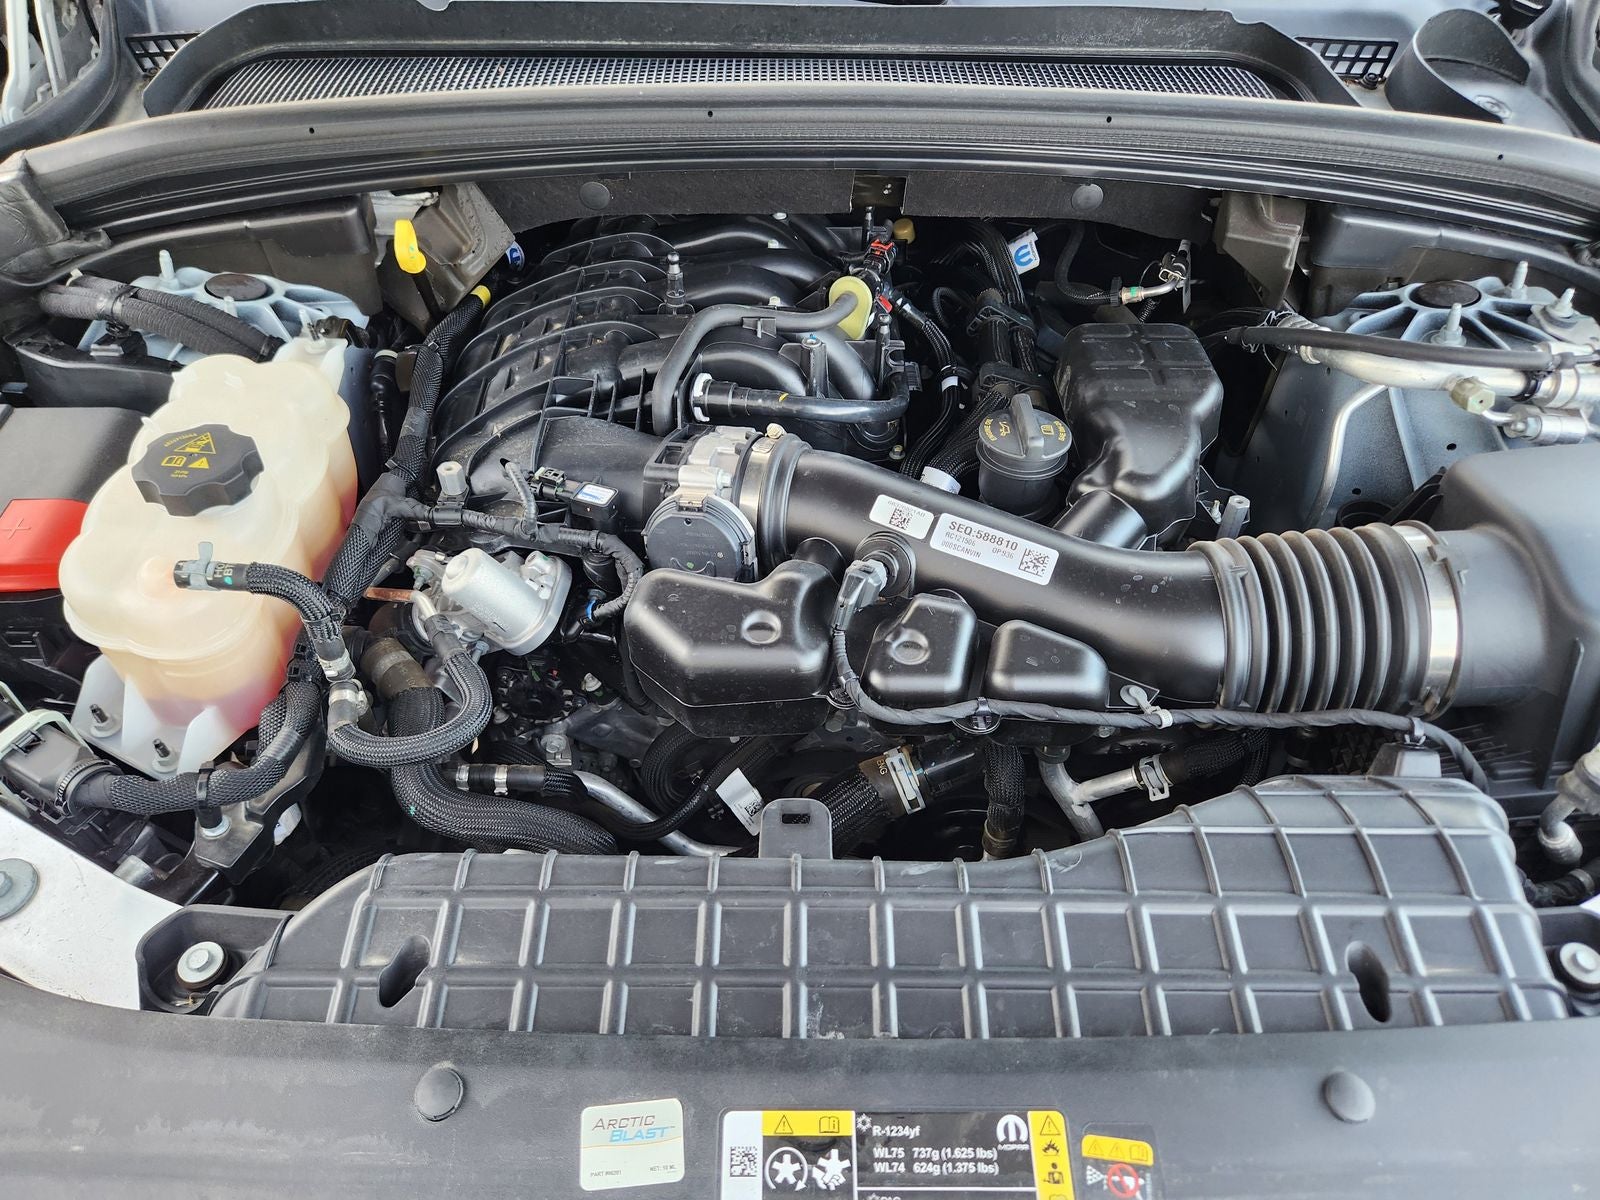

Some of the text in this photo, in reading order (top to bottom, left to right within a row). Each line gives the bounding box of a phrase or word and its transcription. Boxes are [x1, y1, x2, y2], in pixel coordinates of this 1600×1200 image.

[948, 521, 1019, 551] SEQ:588810
[592, 1115, 656, 1131] ARCTIC
[609, 1125, 673, 1143] BLAST
[872, 1125, 921, 1139] R-1234yf
[873, 1147, 998, 1161] WL75 737g (1.625 lbs)
[873, 1162, 1000, 1176] WL74 624g (1.375 lbs)
